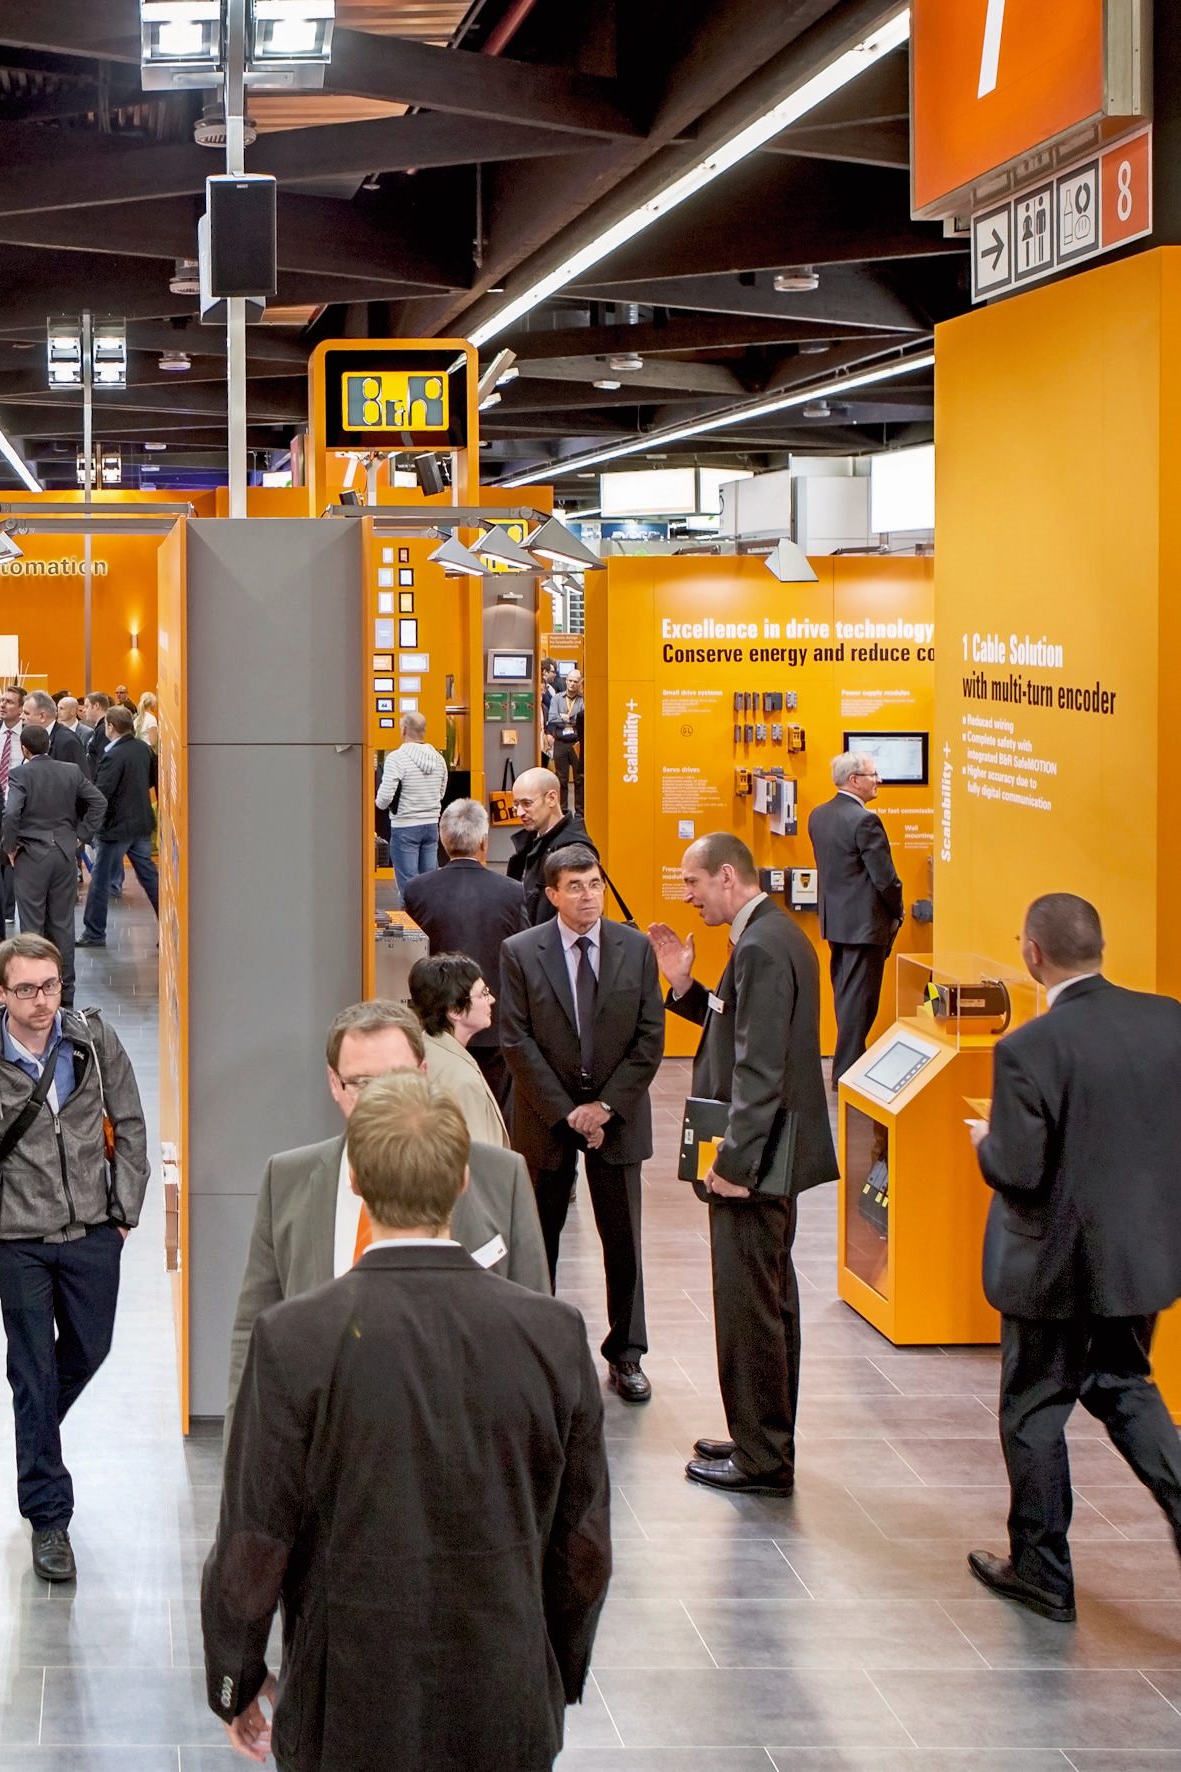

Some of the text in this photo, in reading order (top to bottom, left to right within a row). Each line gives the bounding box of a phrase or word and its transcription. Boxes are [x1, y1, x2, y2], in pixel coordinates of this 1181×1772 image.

[1117, 160, 1132, 222] 8
[662, 618, 935, 644] Excellence in drive technology
[663, 643, 743, 663] Conserve
[749, 648, 807, 667] energy
[814, 643, 844, 662] and
[851, 643, 911, 662] reduce
[962, 632, 1064, 669] 1 Cable Solution
[962, 670, 1117, 715] with multi-turn encoder
